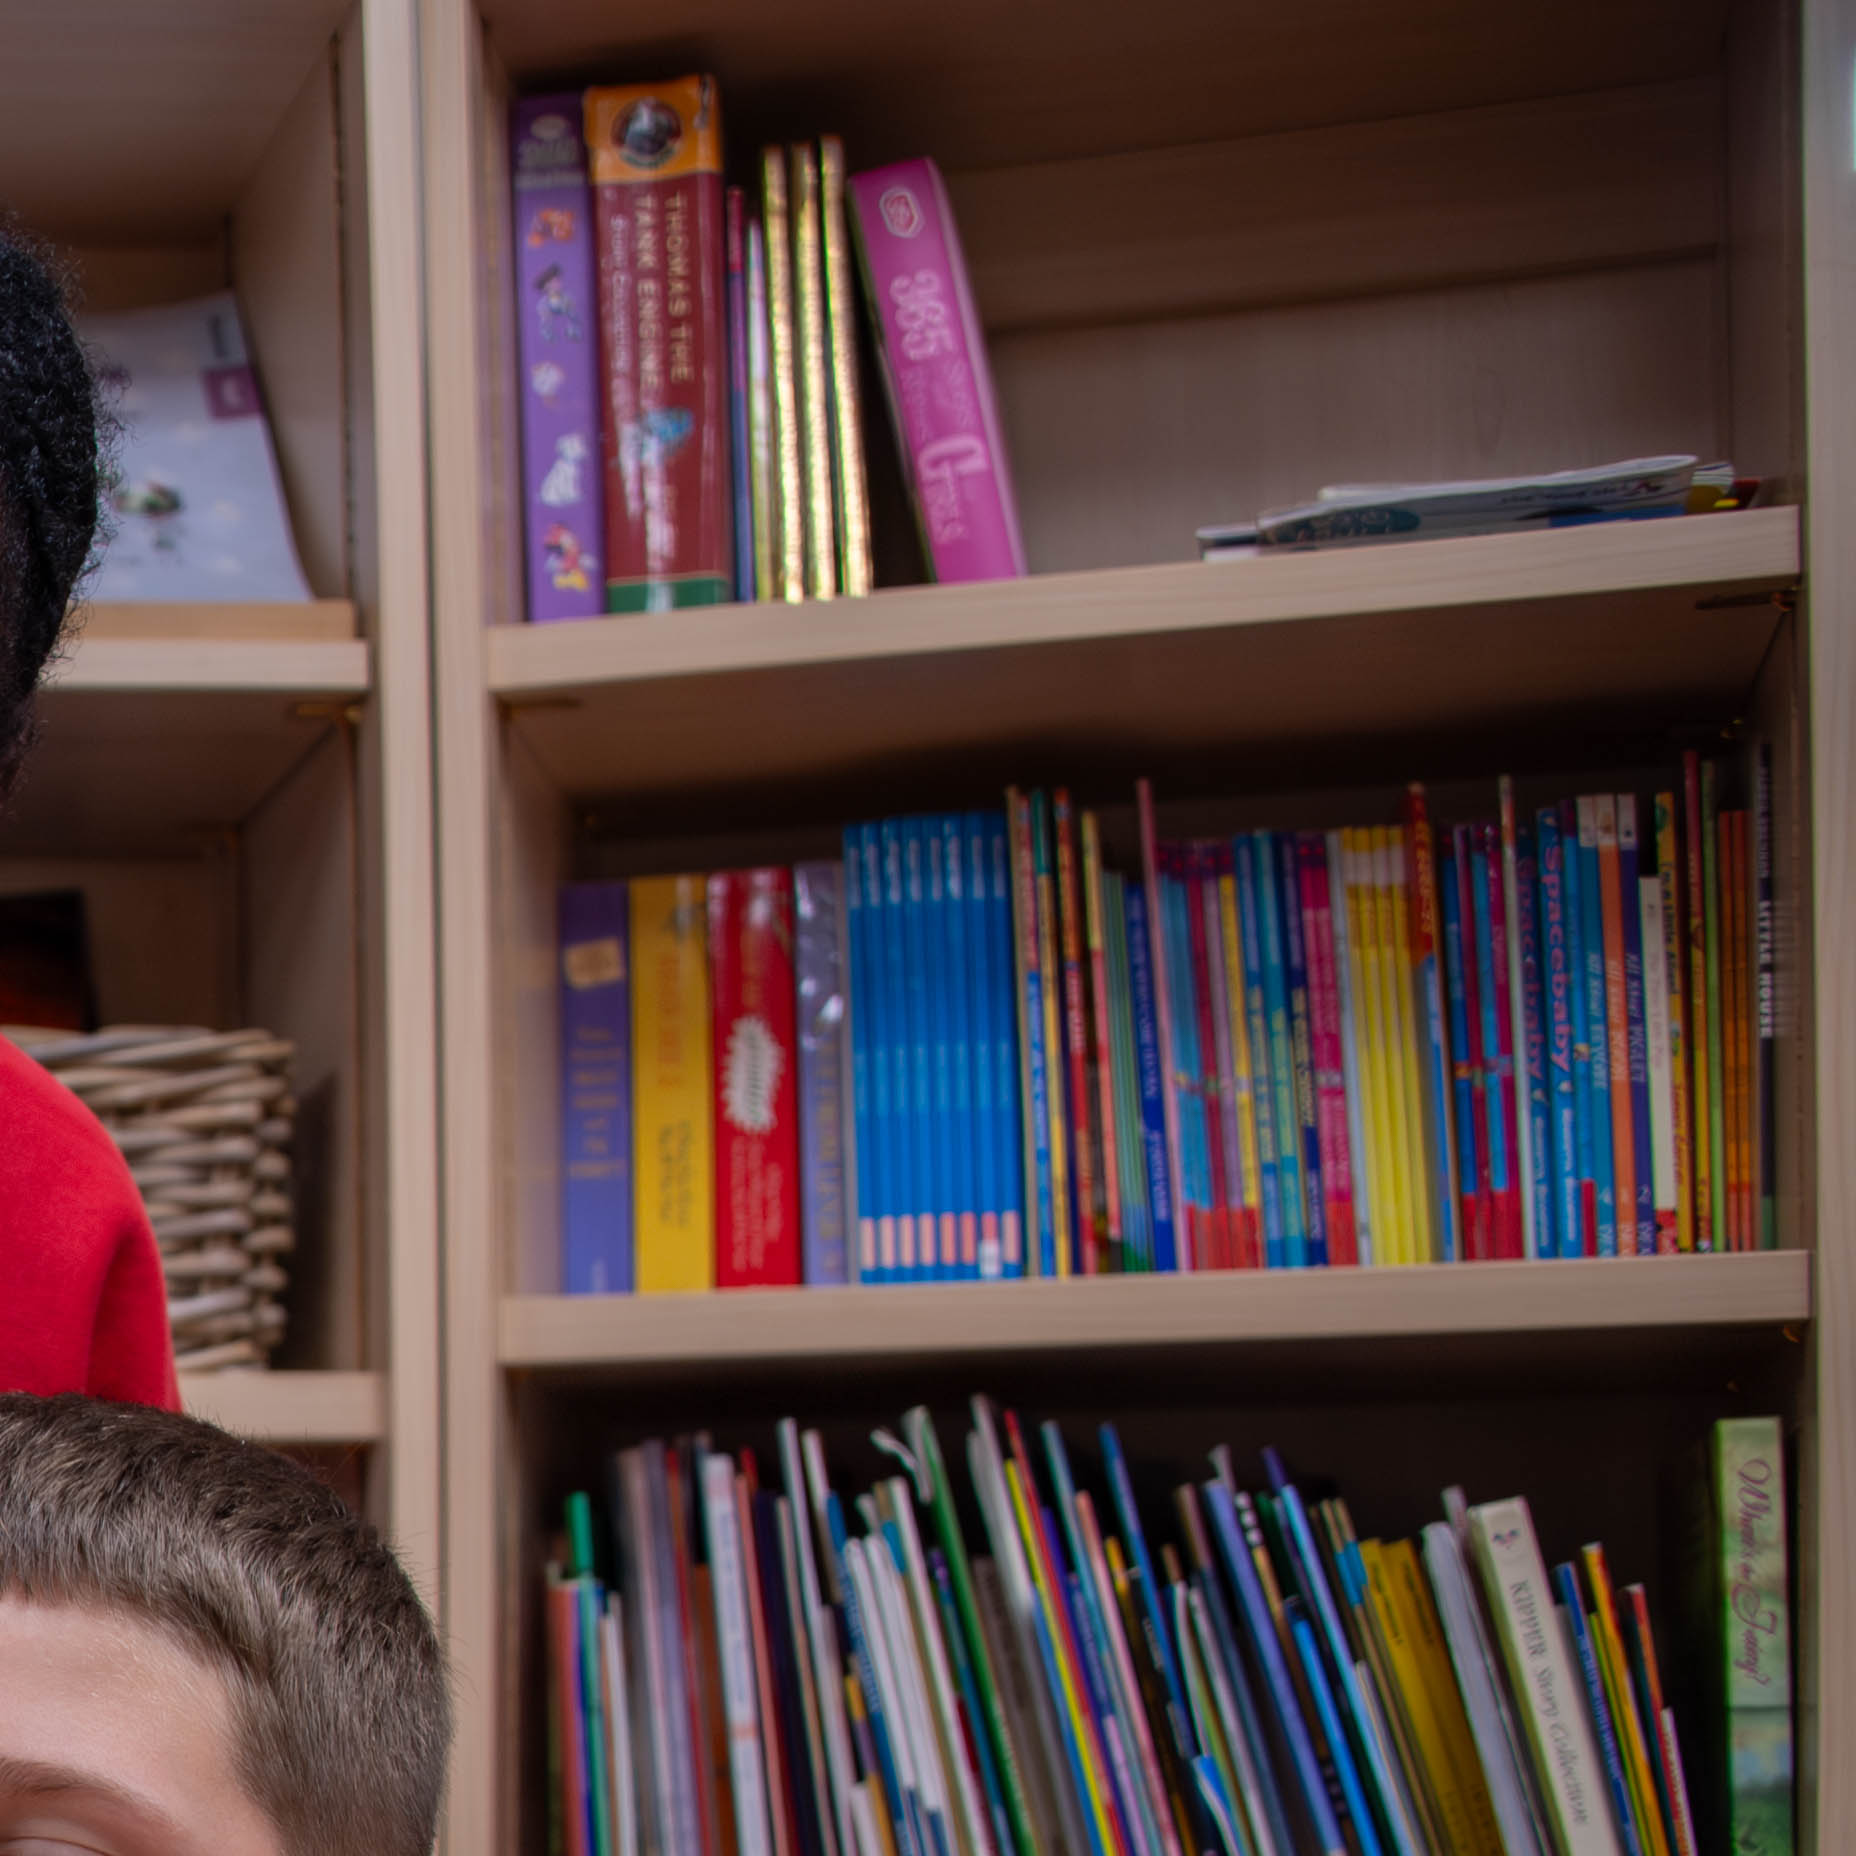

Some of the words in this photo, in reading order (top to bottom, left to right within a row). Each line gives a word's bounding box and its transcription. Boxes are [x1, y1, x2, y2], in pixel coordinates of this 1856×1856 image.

[634, 194, 659, 269] TANK
[665, 193, 690, 316] THOMAS
[669, 324, 694, 382] THE
[889, 269, 955, 361] 365
[1541, 843, 1570, 1072] Spacebaby
[1511, 1581, 1547, 1663] KIPPER
